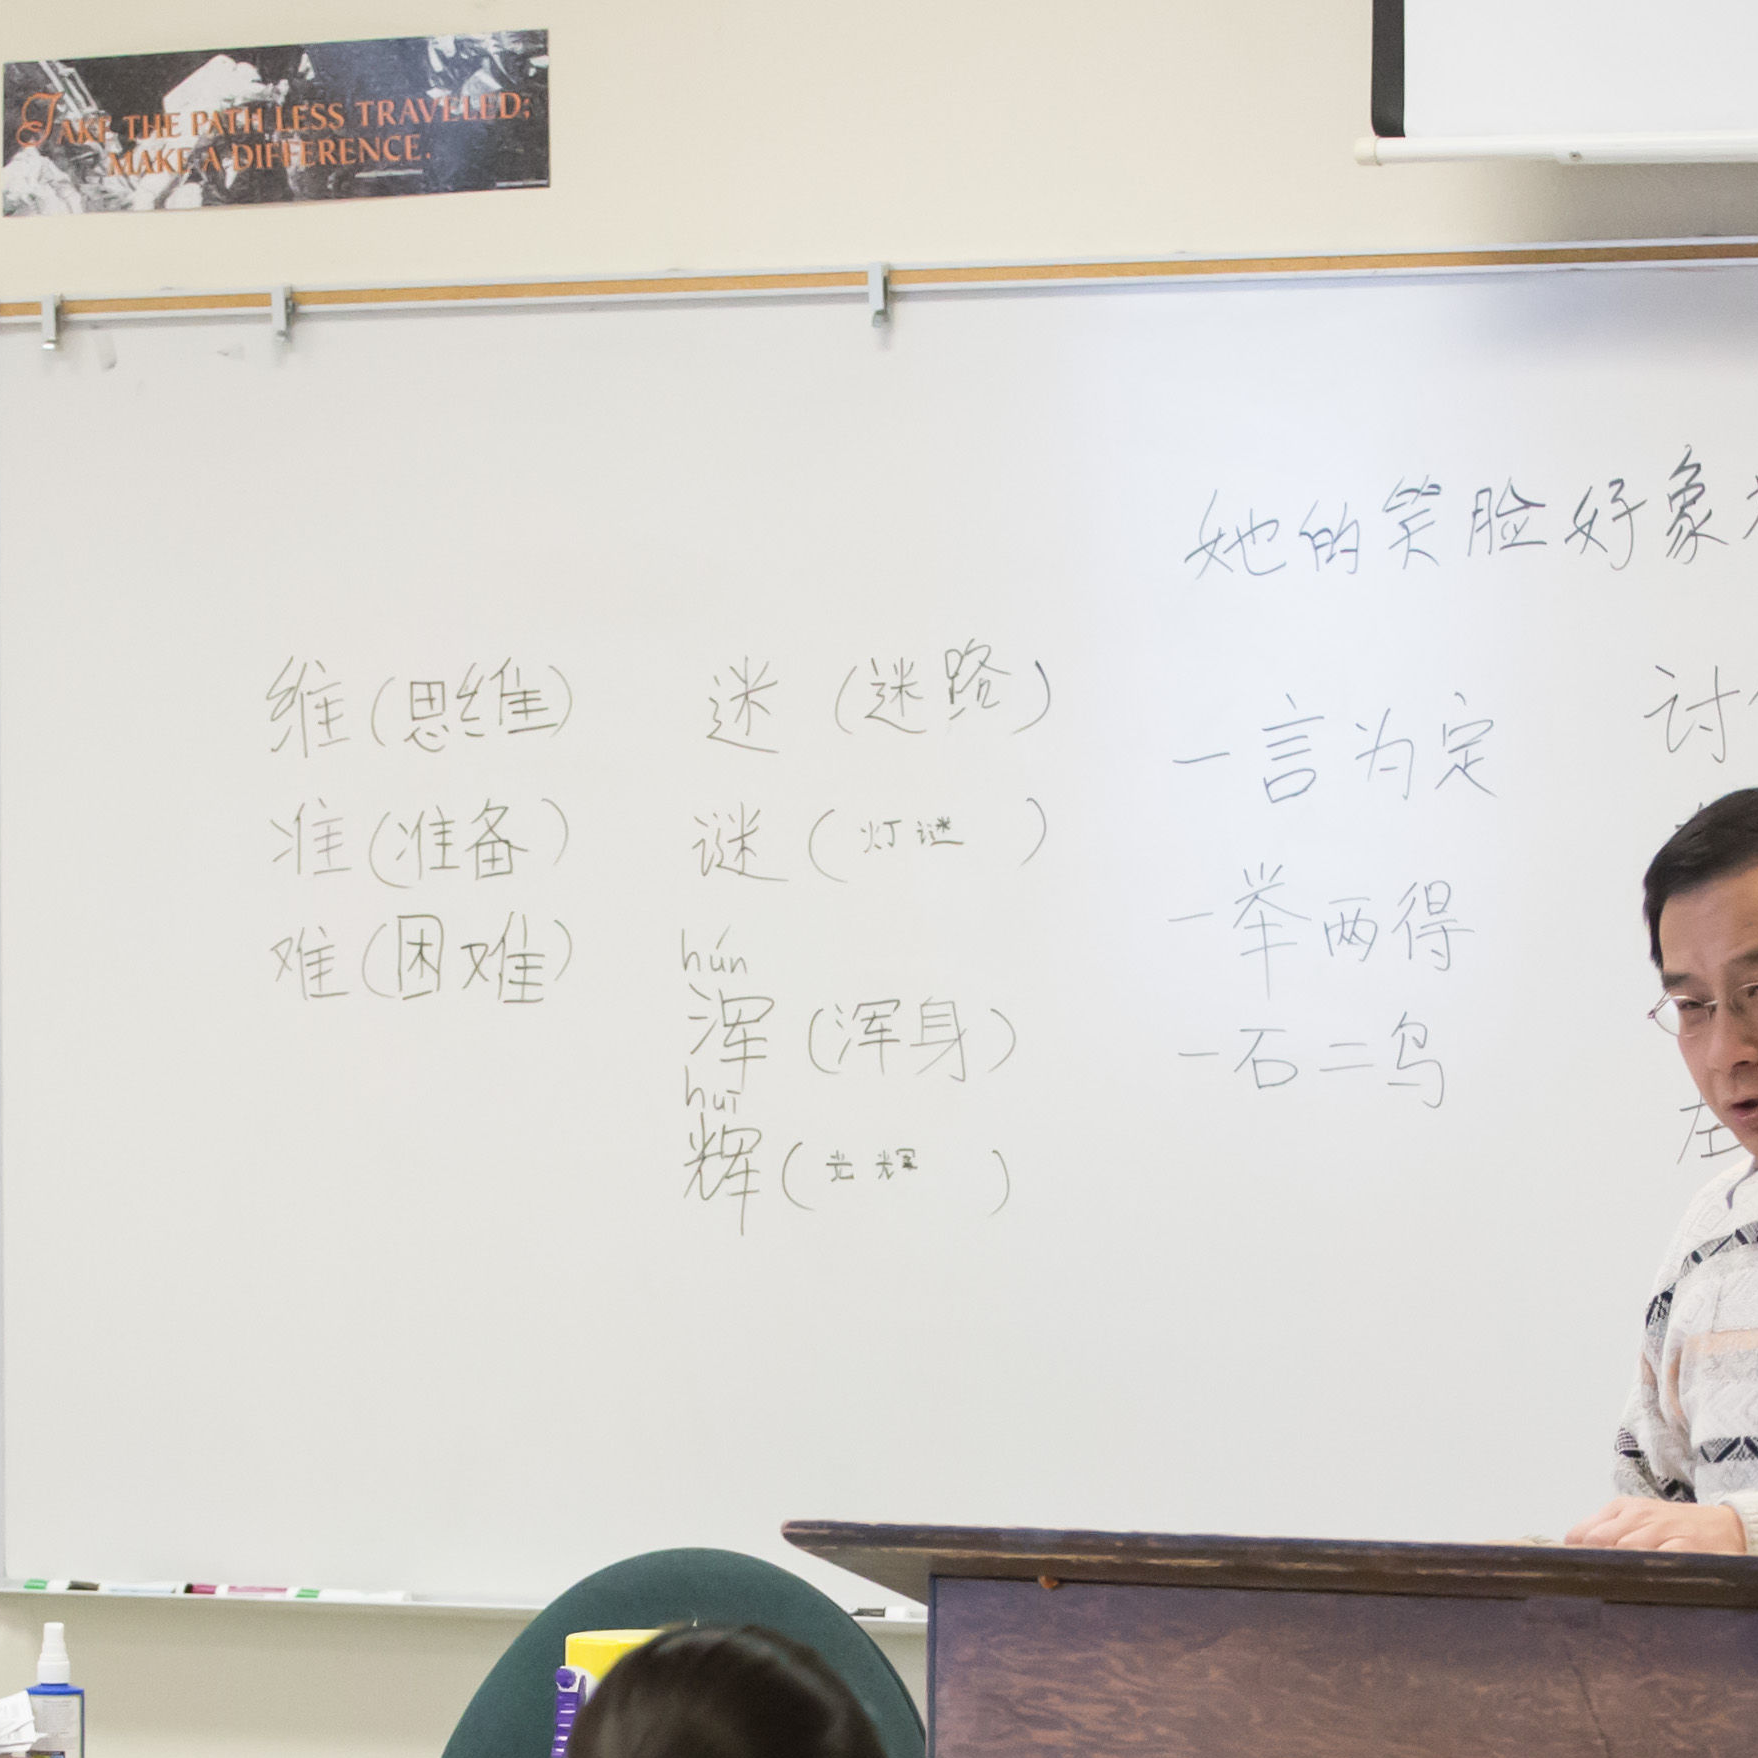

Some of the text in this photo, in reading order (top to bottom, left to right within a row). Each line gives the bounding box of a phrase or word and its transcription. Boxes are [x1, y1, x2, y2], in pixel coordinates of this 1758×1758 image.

[16, 91, 531, 148] TAKE THE PATH LESS TRAVELED;
[108, 133, 432, 177] MAKE A DIFFERENCE.
[1173, 692, 1498, 803] 一言为定
[1168, 862, 1476, 1000] 一举两得
[1178, 1011, 1446, 1109] 一石二鸟
